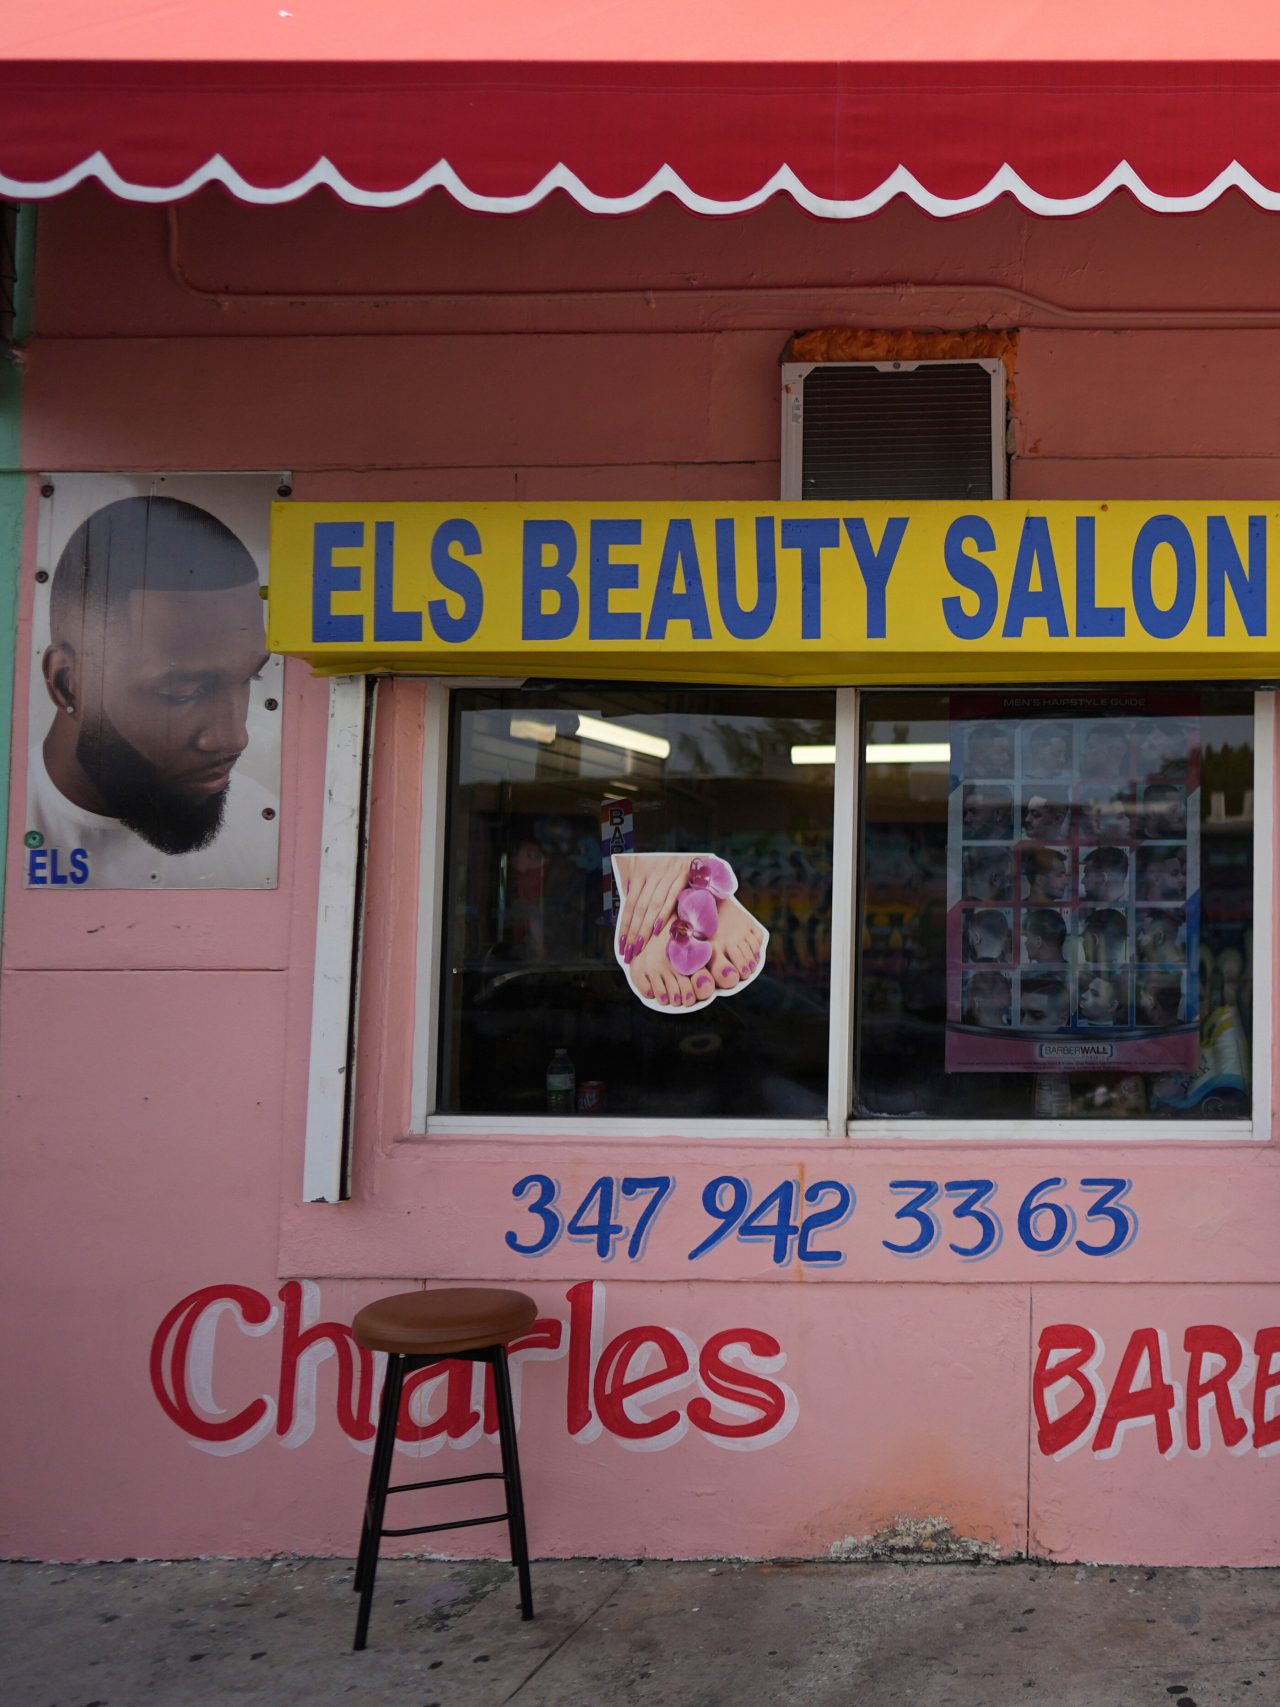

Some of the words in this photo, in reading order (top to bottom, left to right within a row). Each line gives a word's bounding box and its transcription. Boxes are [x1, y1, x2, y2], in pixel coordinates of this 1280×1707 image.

[312, 519, 484, 643] ELS
[522, 516, 909, 641] BEAUTY
[942, 514, 1267, 640] SALON
[1110, 698, 1146, 707] GUIDE
[28, 847, 91, 886] ELS
[1044, 1045, 1109, 1056] BARBERWALL
[504, 1174, 677, 1261] 347
[687, 1176, 857, 1267] 942
